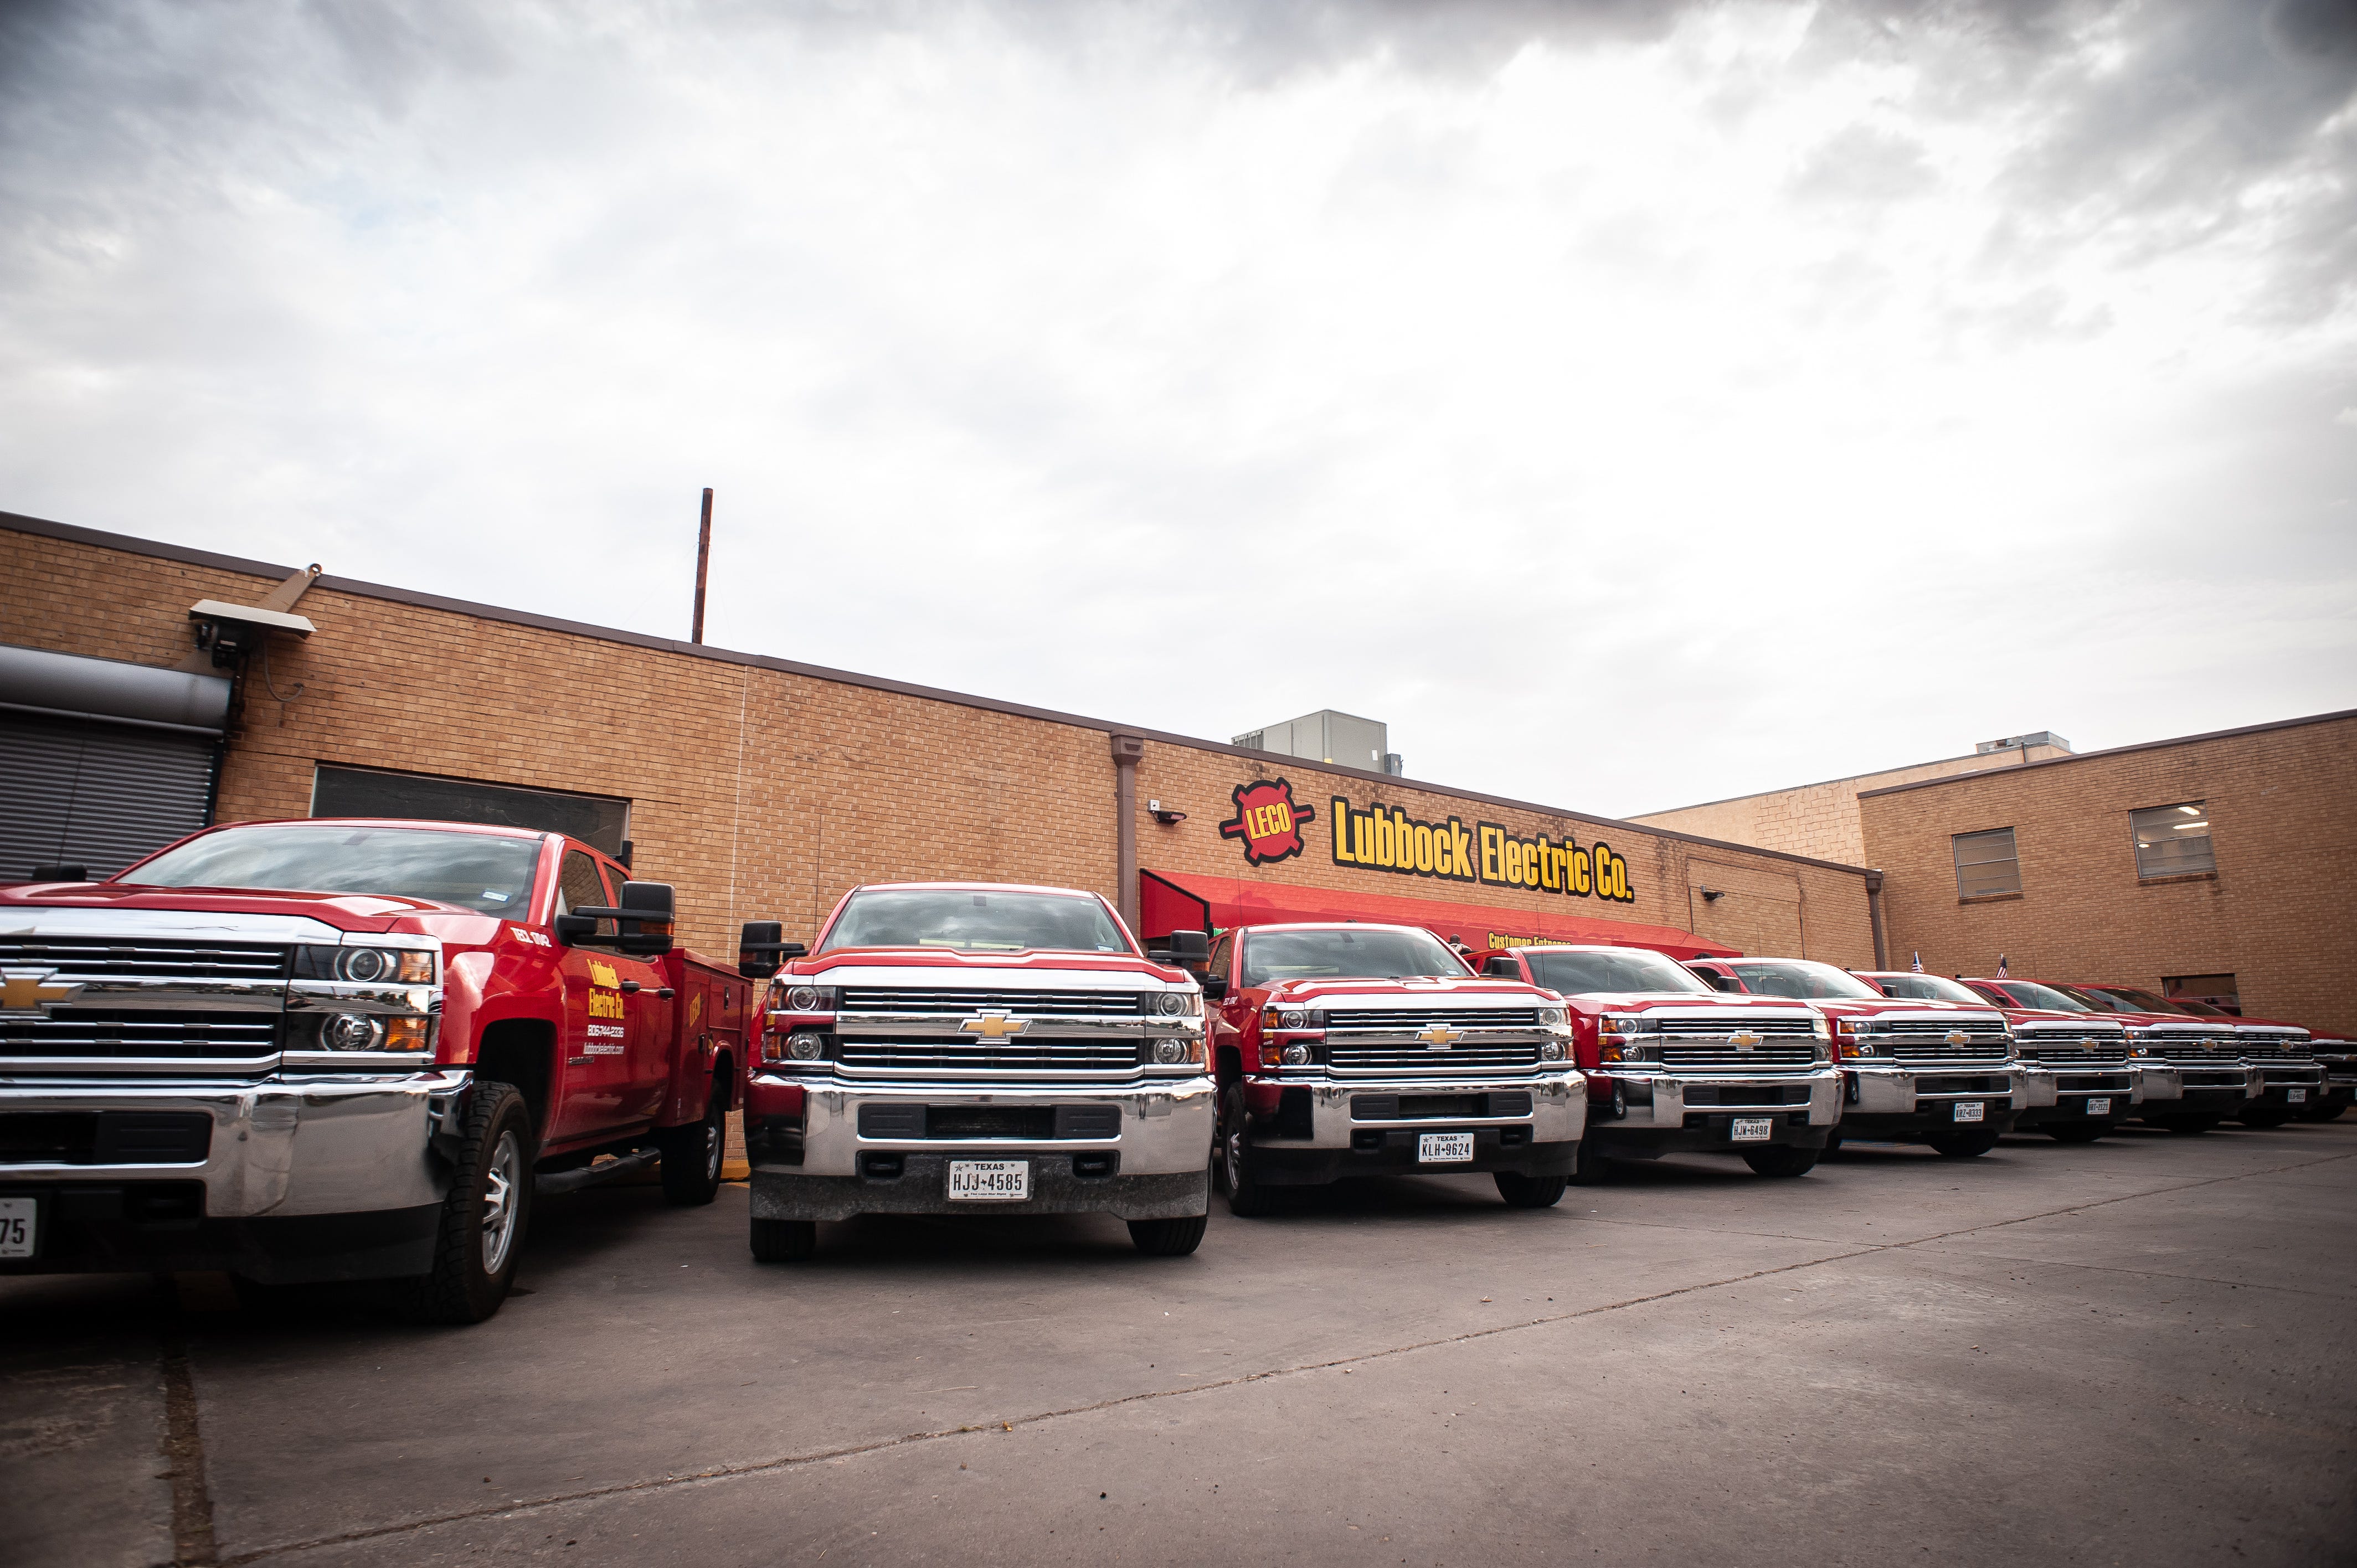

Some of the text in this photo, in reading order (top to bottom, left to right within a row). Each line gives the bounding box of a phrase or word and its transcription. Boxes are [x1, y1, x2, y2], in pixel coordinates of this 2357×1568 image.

[1245, 802, 1291, 840] LECO
[1335, 801, 1632, 899] Lubbock Electric Co.
[588, 988, 615, 1018] Electric
[0, 1218, 25, 1245] 75
